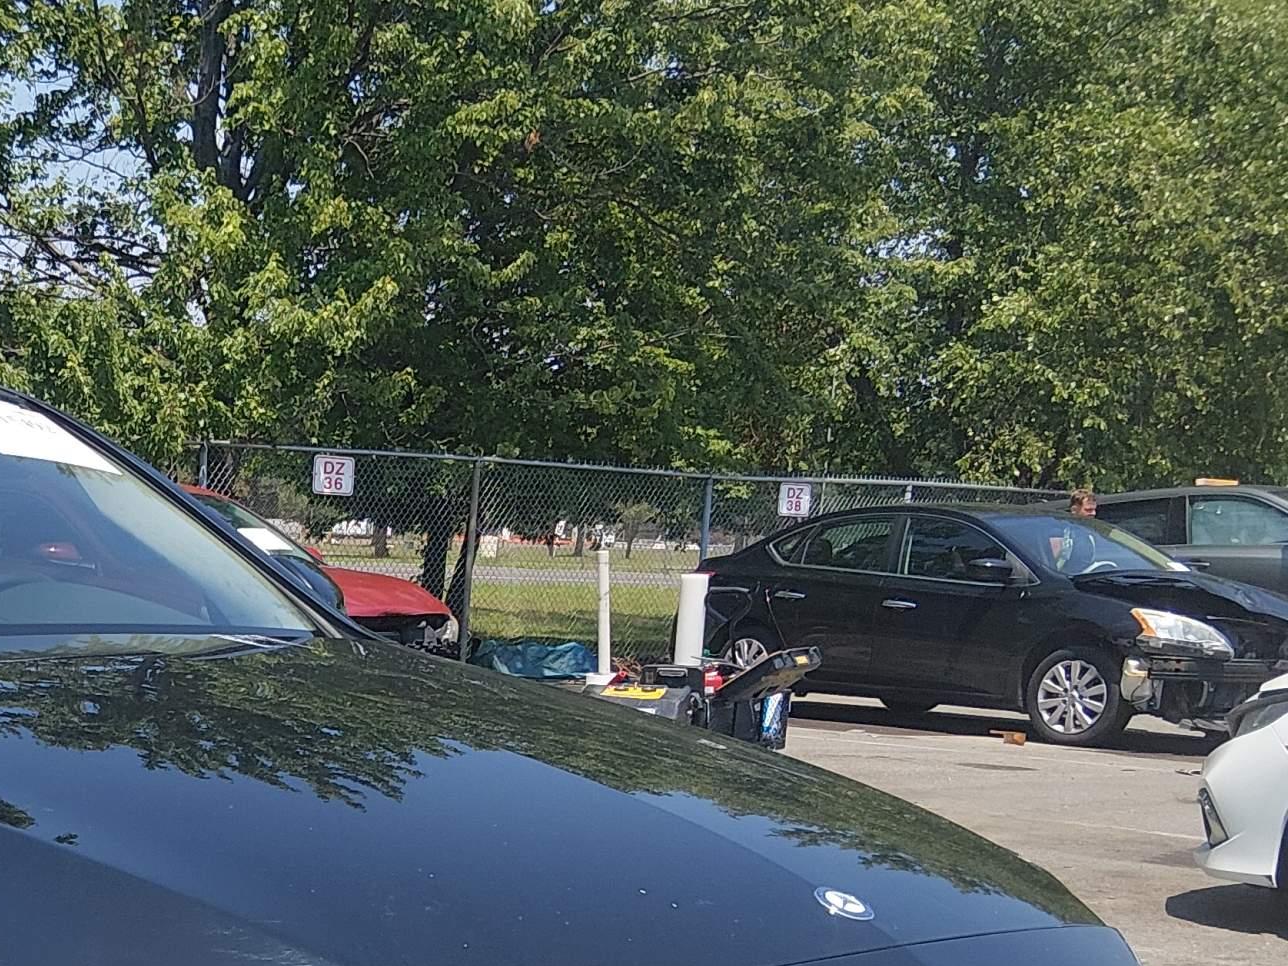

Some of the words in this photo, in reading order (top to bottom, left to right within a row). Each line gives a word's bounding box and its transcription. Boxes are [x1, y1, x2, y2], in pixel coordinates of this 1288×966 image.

[323, 461, 346, 476] DZ
[323, 476, 344, 491] 36
[787, 487, 805, 500] DZ
[786, 500, 802, 512] 38
